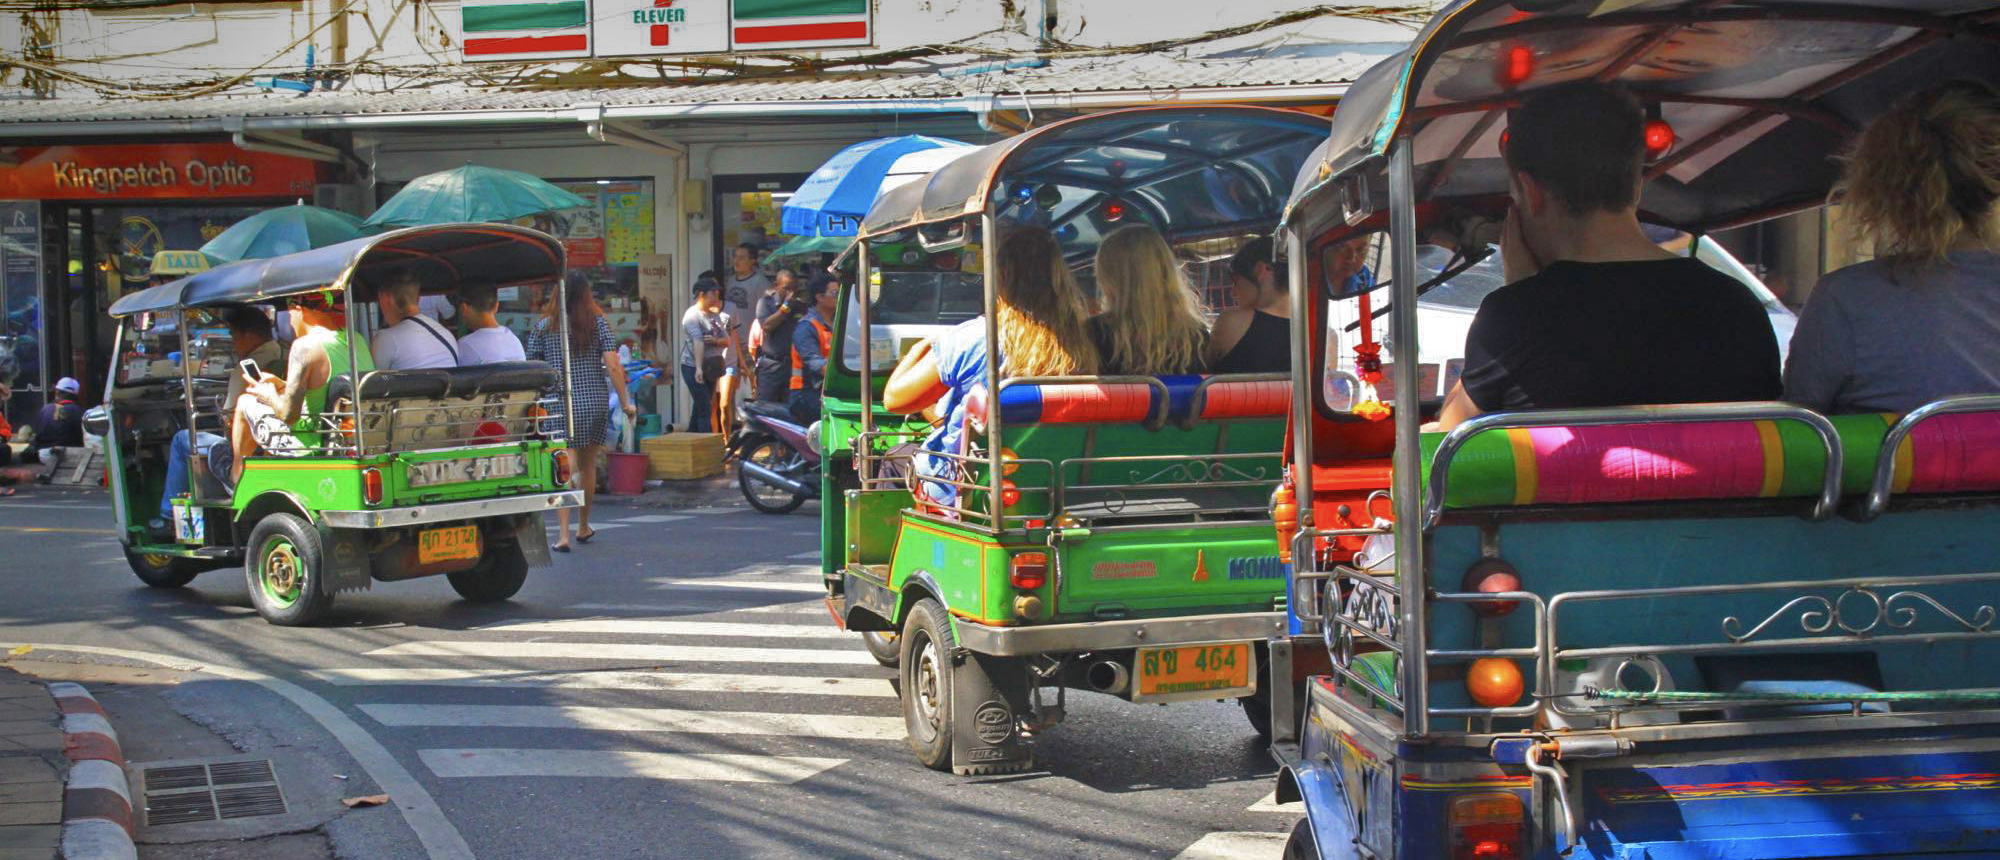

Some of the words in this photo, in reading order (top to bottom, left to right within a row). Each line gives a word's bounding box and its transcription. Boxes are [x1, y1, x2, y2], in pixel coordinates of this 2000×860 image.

[52, 160, 177, 191] Kingpetch
[185, 160, 252, 190] Optic
[165, 253, 201, 269] TAXI
[1195, 645, 1236, 672] 464
